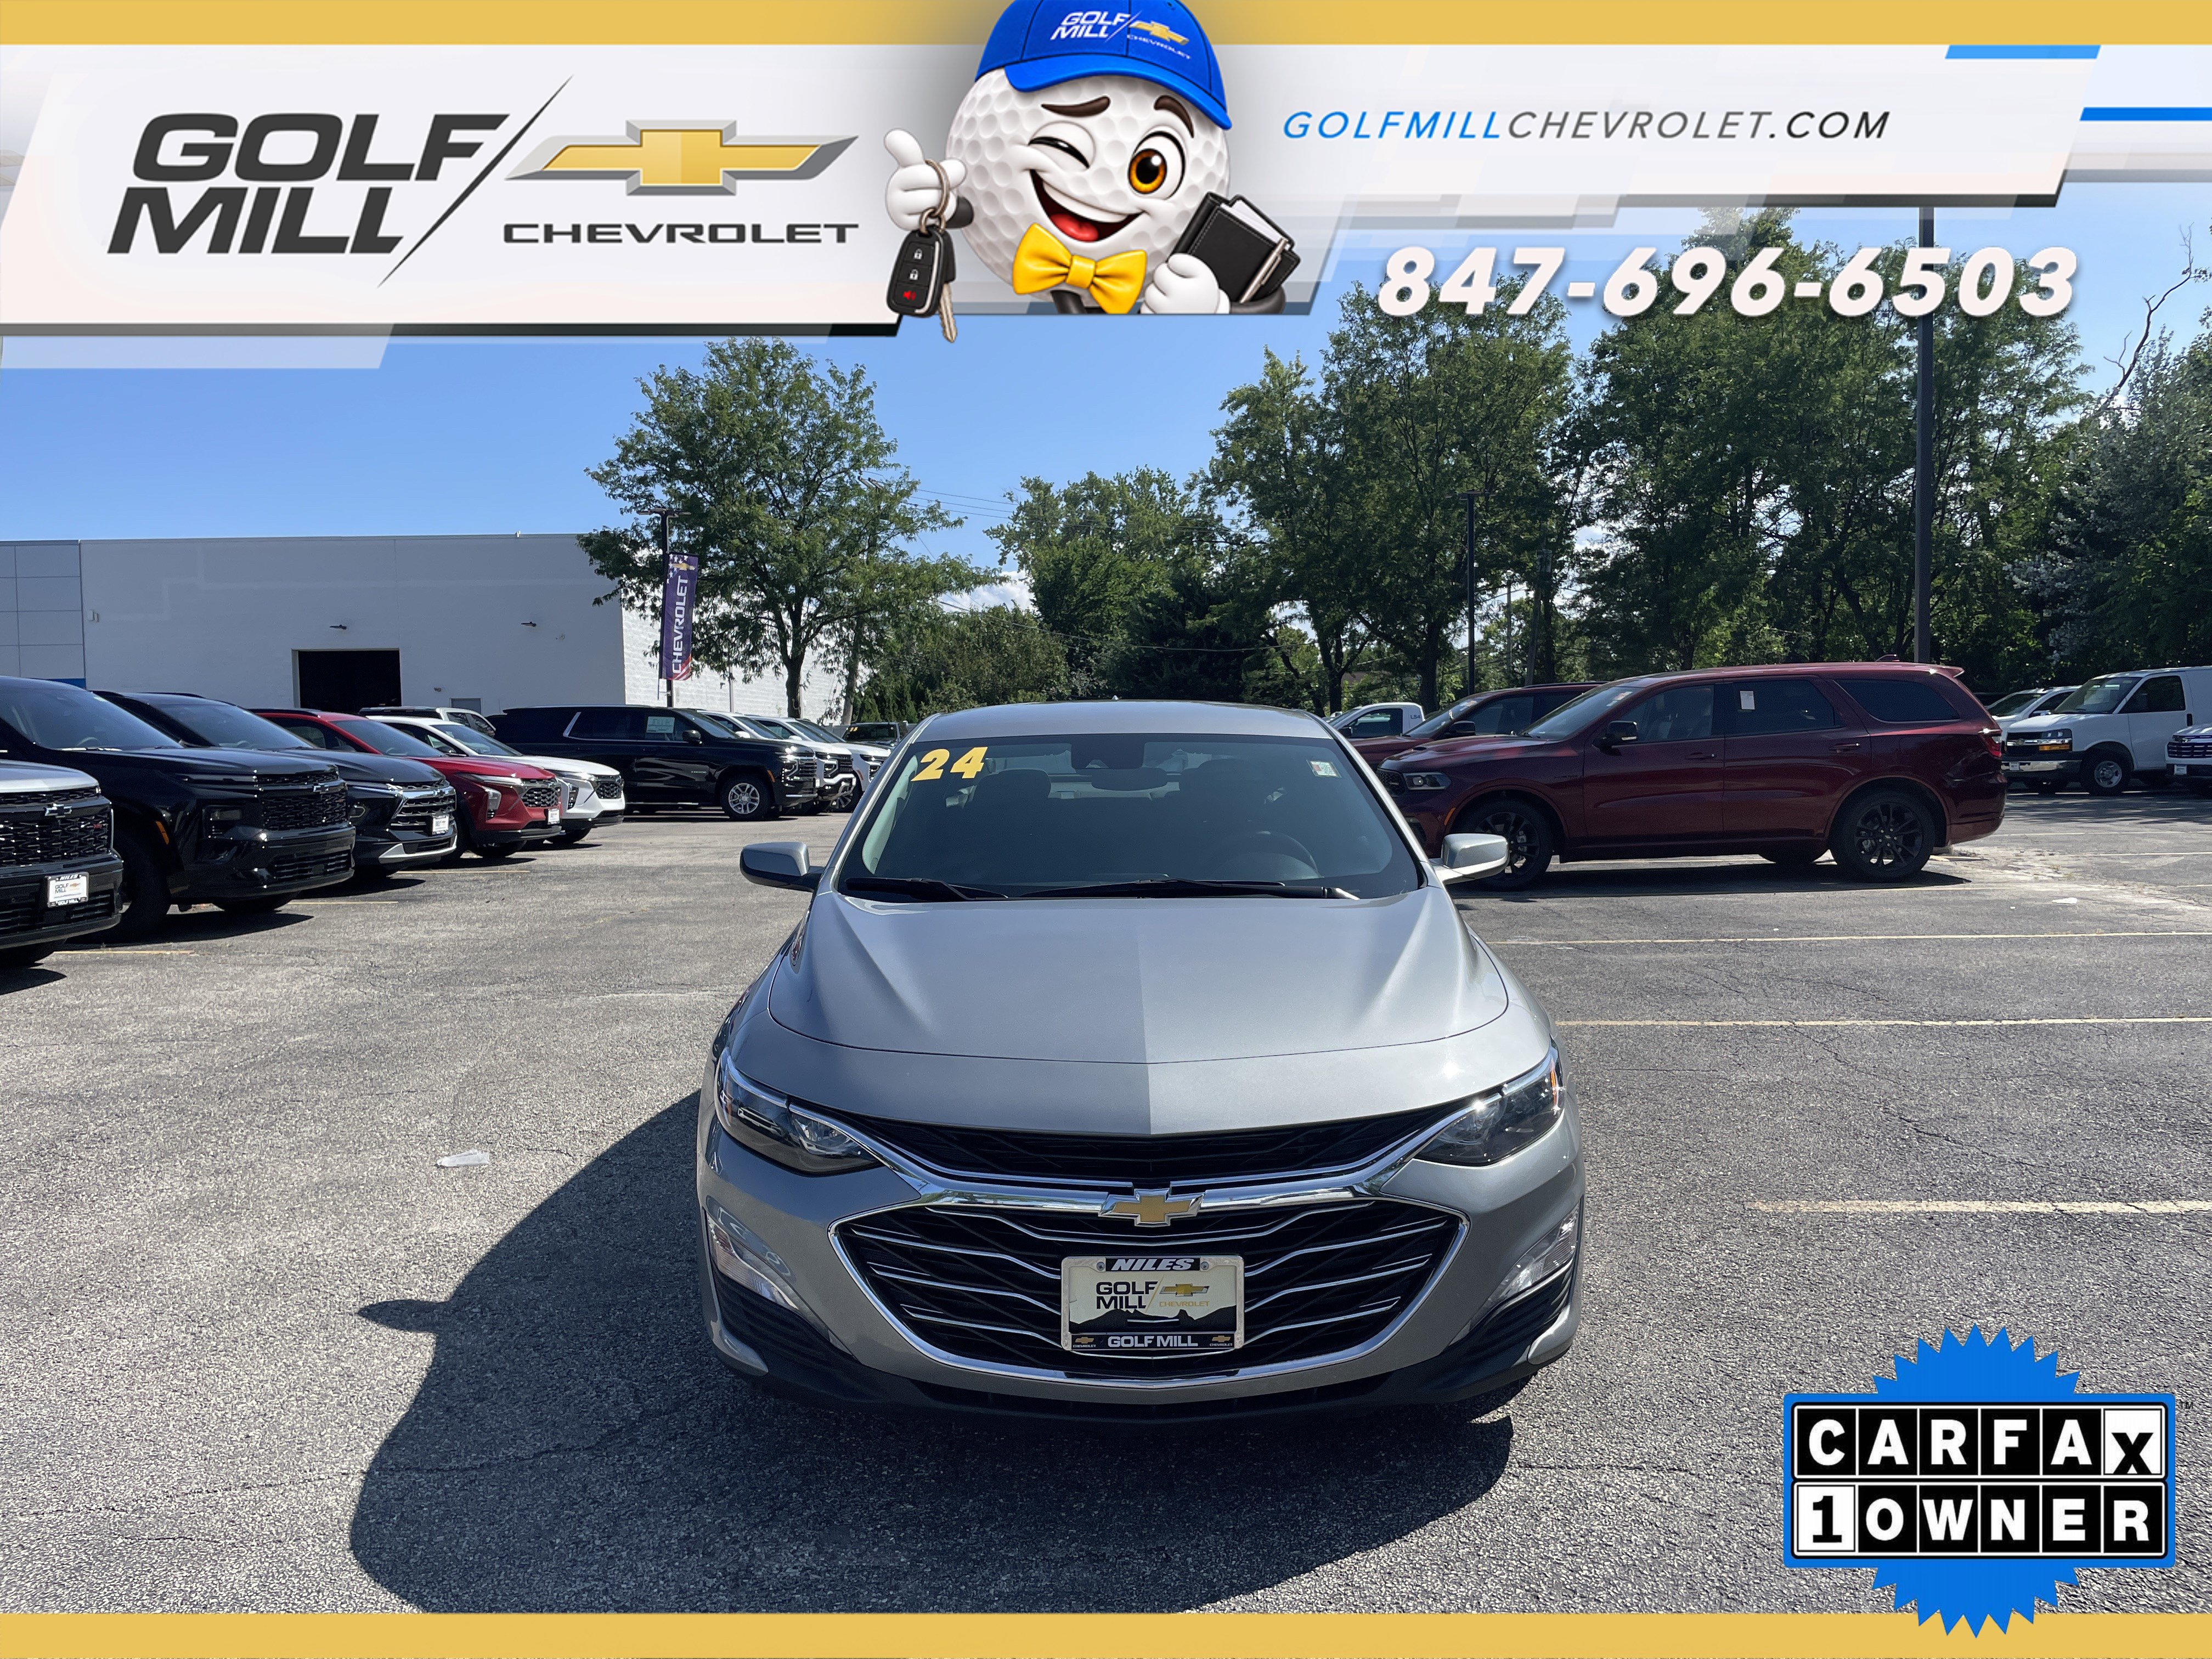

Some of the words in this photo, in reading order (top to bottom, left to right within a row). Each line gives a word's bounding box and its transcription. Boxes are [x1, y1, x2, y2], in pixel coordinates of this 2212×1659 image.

[672, 575, 688, 674] CHEVROLET
[911, 747, 988, 782] 24
[1111, 1259, 1194, 1271] NILES
[1096, 1281, 1158, 1295] GOLF
[1097, 1296, 1147, 1309] MILL
[1107, 1336, 1154, 1347] GOLF
[1156, 1335, 1198, 1347] MILL
